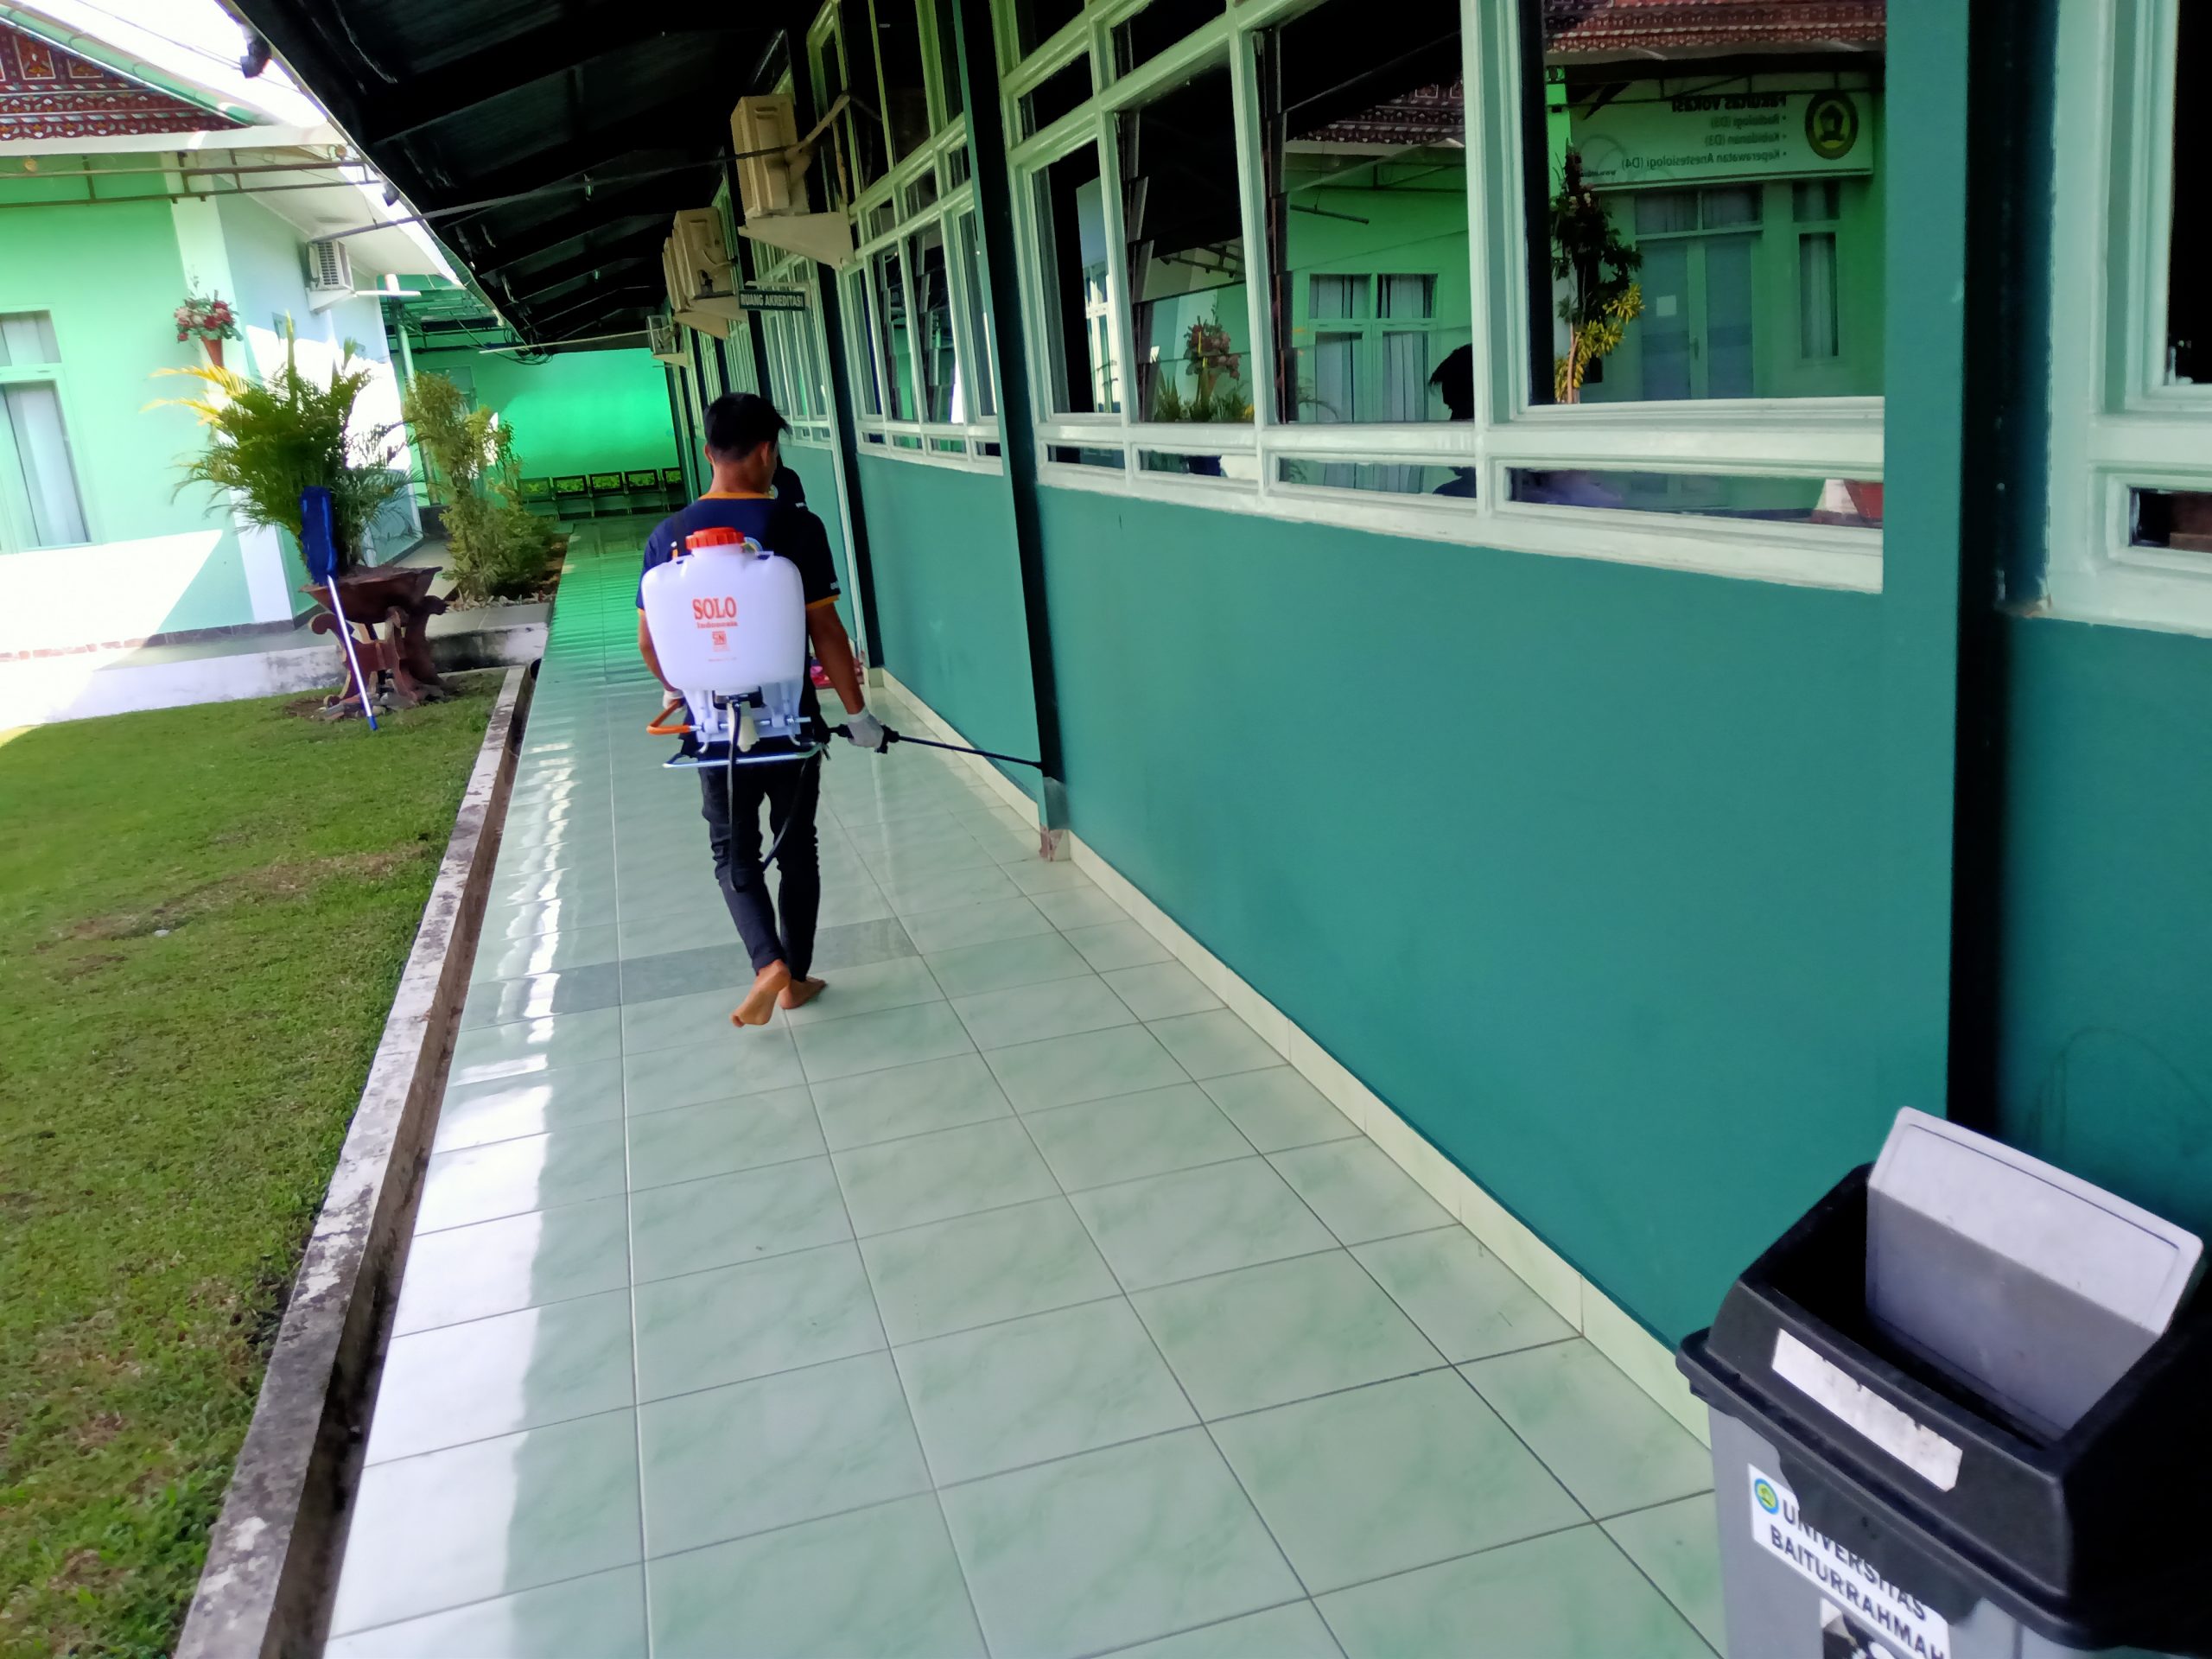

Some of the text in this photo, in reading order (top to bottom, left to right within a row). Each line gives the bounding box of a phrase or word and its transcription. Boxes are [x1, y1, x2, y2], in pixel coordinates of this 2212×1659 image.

[741, 294, 804, 308] RUANG AKREDITASI
[692, 596, 737, 620] SOLO
